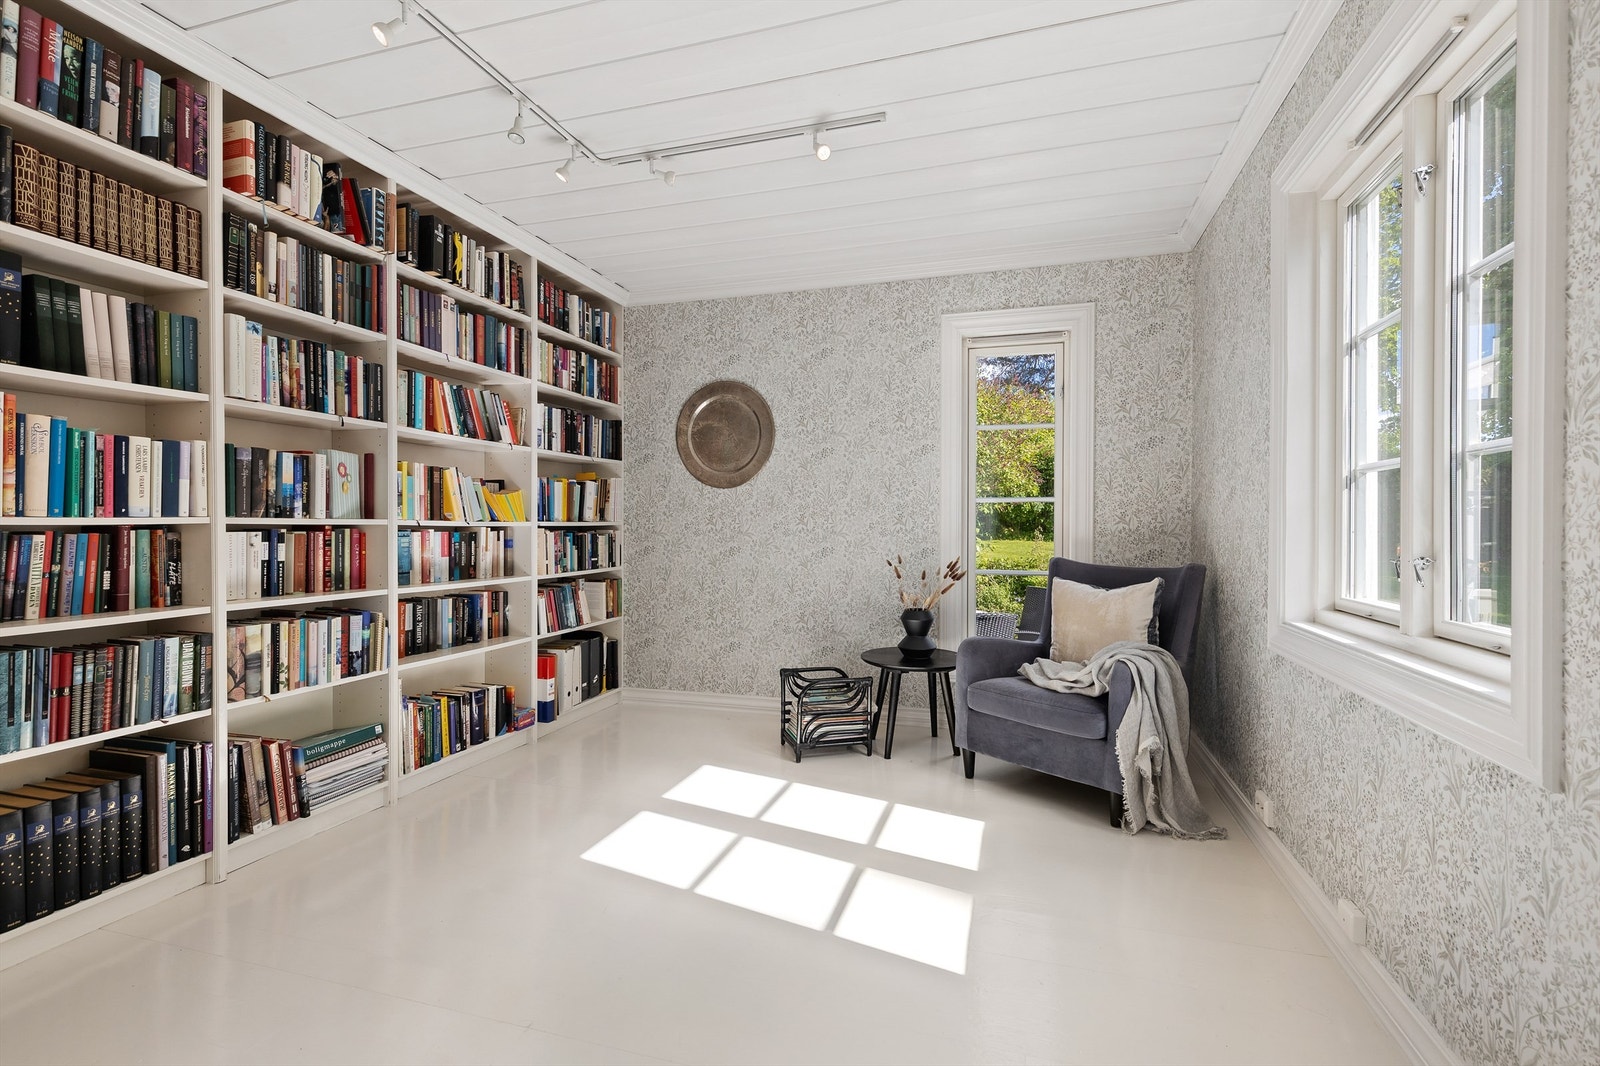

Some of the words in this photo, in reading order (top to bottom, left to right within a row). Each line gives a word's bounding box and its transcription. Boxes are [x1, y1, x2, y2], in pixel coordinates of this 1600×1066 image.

[44, 28, 61, 63] Mykle
[63, 29, 83, 44] NELSON
[182, 642, 194, 658] DAN
[181, 659, 194, 688] BROWN
[306, 738, 346, 756] boligmappe
[167, 762, 176, 800] FRANKRIKE
[275, 753, 286, 811] Conquistadorene
